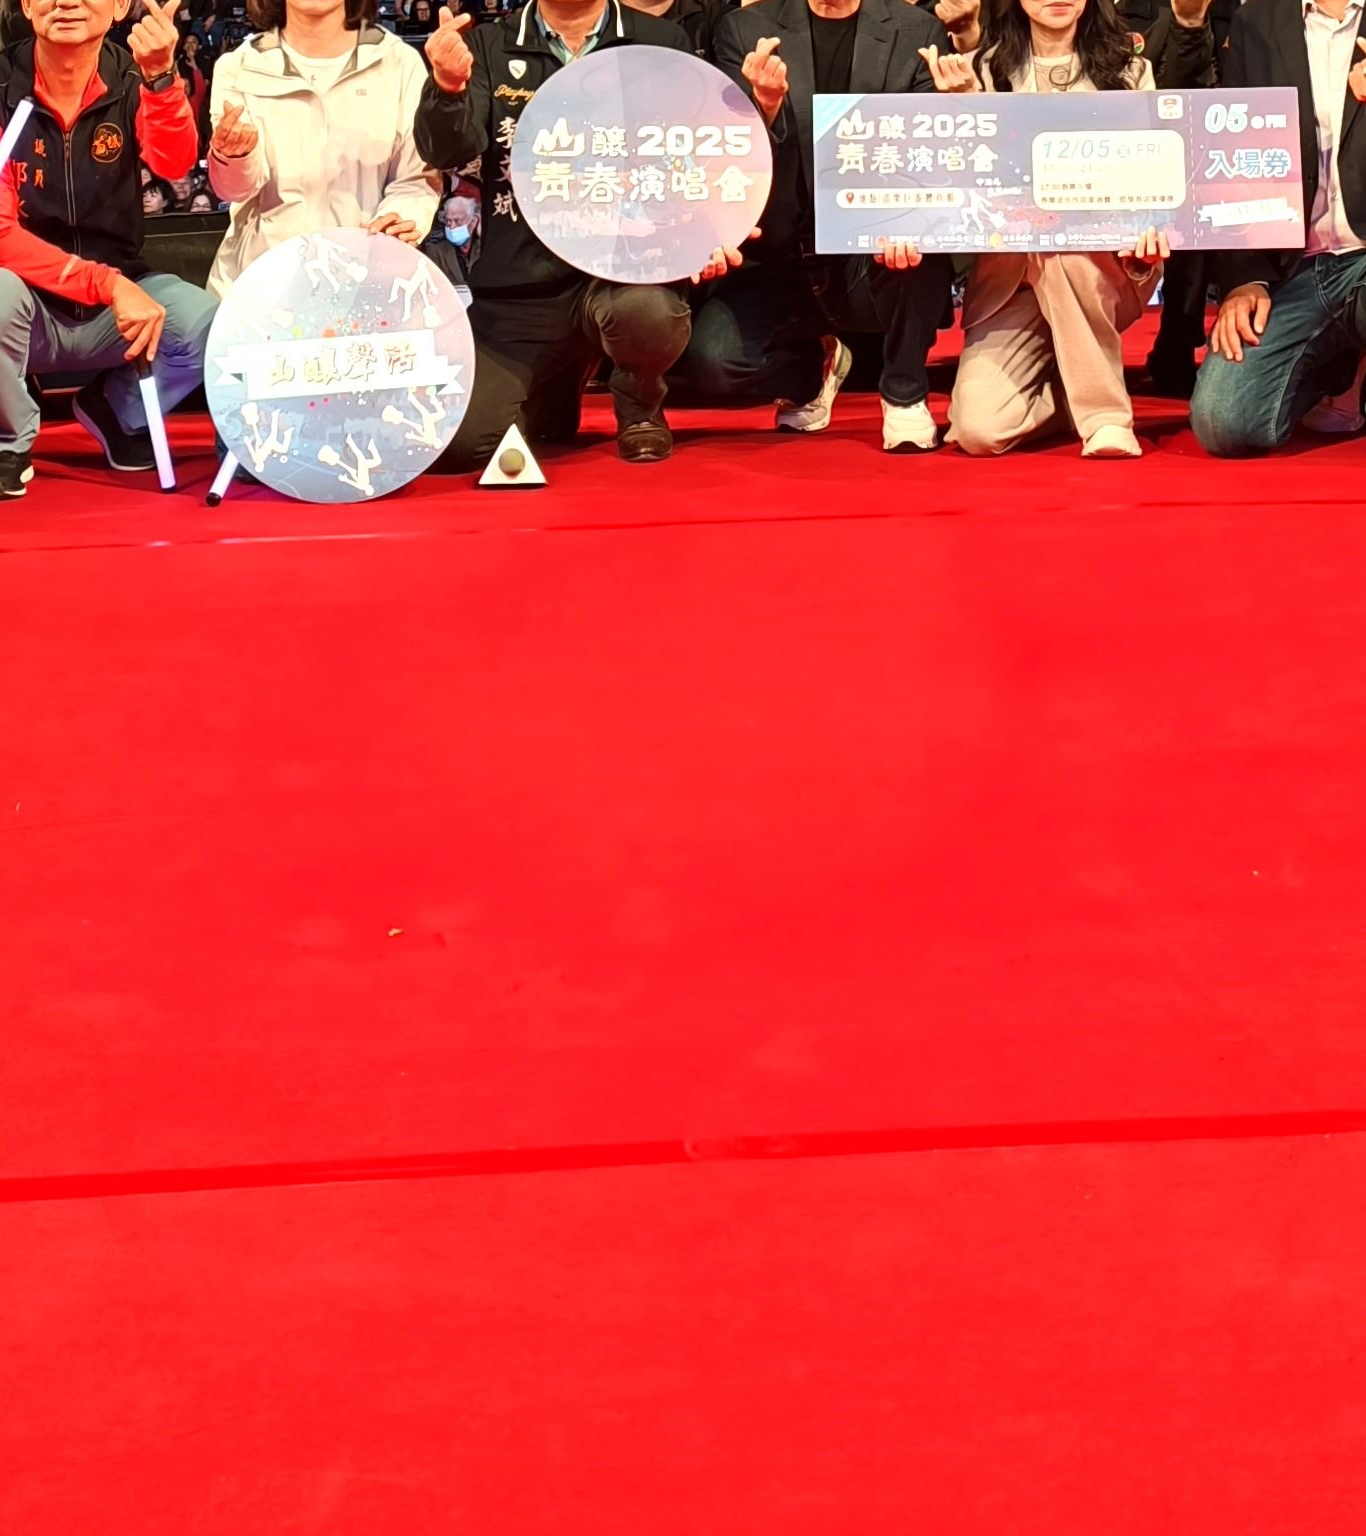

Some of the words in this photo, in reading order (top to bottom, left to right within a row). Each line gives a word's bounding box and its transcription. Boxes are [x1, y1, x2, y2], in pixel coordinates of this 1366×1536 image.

[912, 113, 998, 139] 2025
[1204, 103, 1248, 134] 05
[637, 125, 752, 157] 2025
[1043, 139, 1111, 159] 12/05
[835, 142, 999, 175] 青春演唱會
[1205, 148, 1291, 179] 入場券
[531, 161, 754, 204] 青春演唱會
